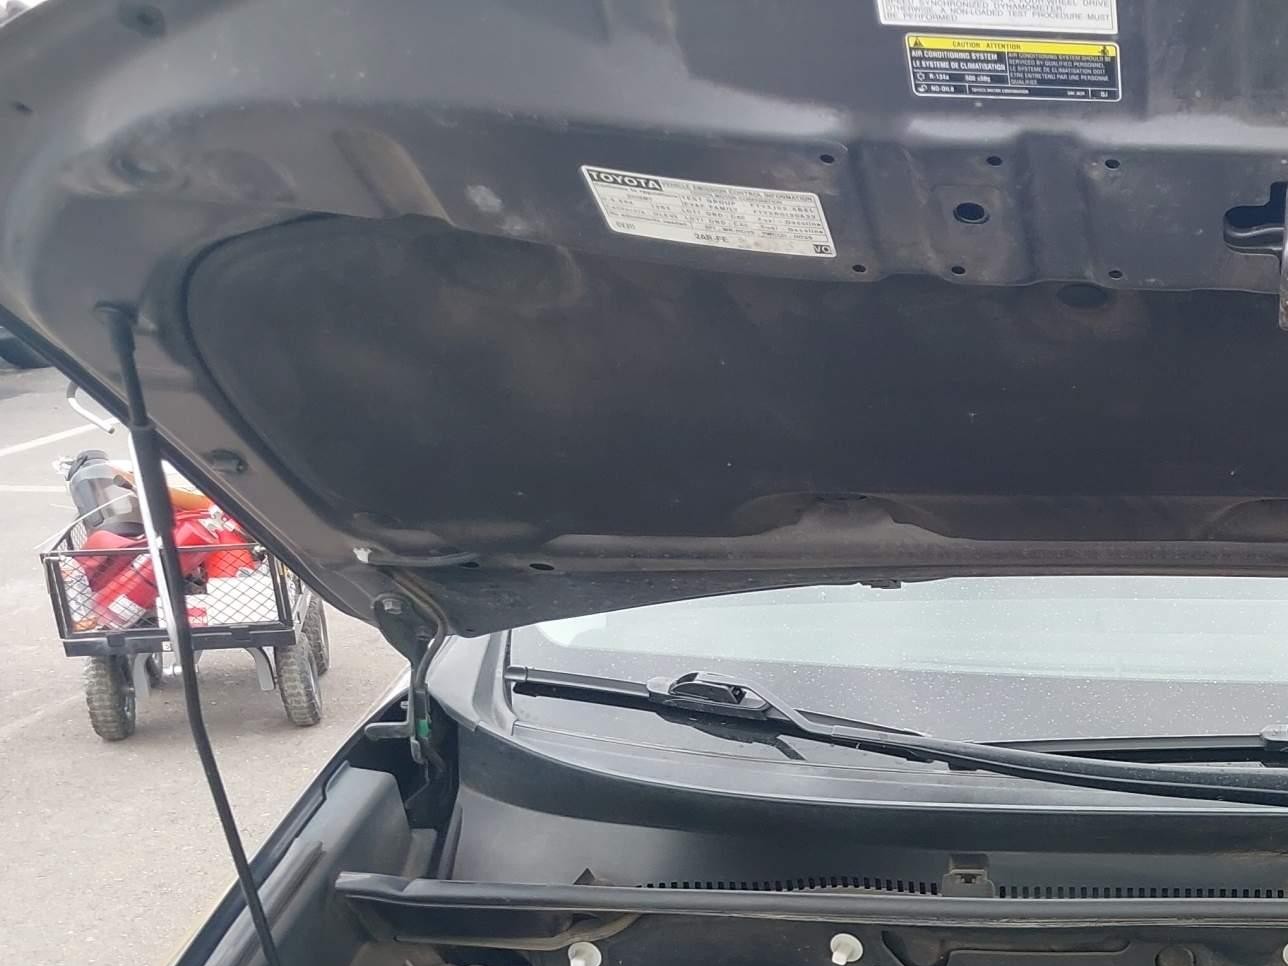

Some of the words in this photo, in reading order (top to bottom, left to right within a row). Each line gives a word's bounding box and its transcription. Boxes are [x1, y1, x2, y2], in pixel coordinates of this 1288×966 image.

[987, 42, 1021, 50] ATTENTION
[912, 50, 923, 58] AIR
[924, 50, 970, 59] CONDITIONING
[971, 52, 998, 60] SYSTEM
[960, 62, 1006, 71] CLIMATISATION
[589, 170, 660, 189] TOYOTA
